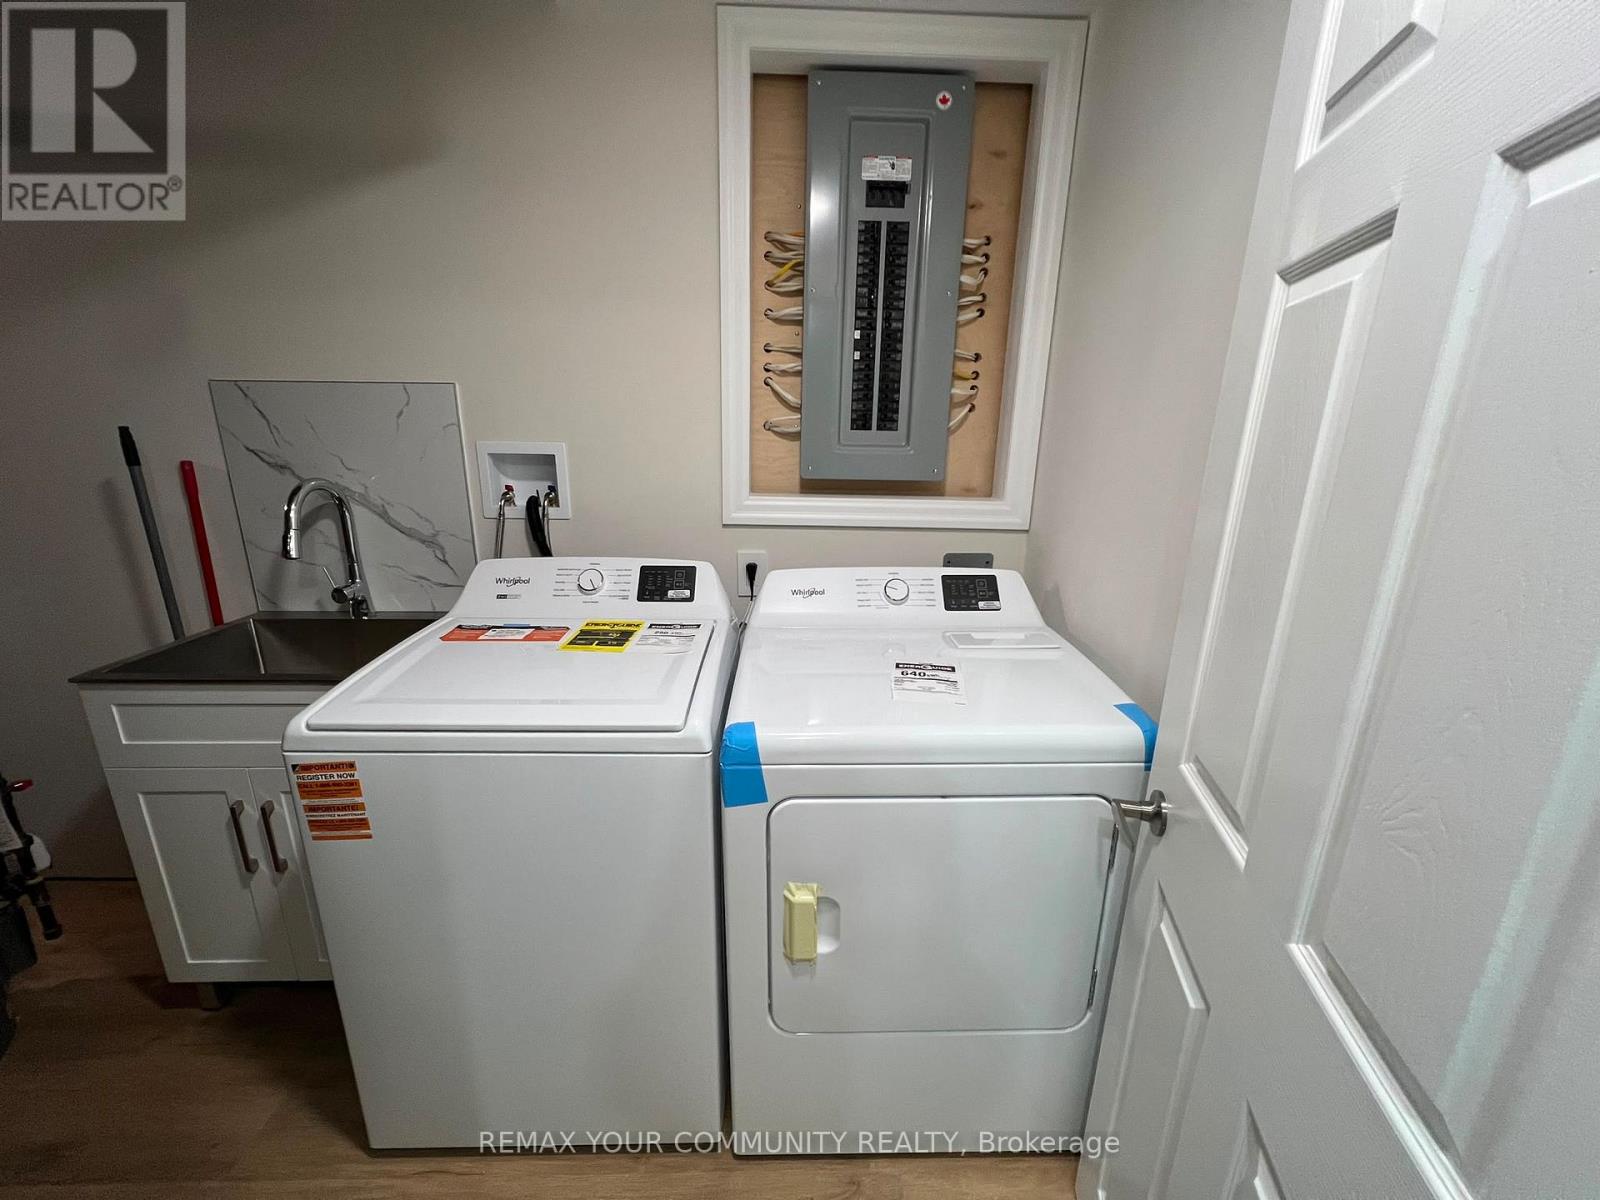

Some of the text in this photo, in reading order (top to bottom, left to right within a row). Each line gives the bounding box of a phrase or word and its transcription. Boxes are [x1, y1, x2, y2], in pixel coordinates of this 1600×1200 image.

[495, 576, 531, 588] Whirlpool
[791, 587, 825, 599] Whirlpool
[296, 773, 335, 781] REGISTER
